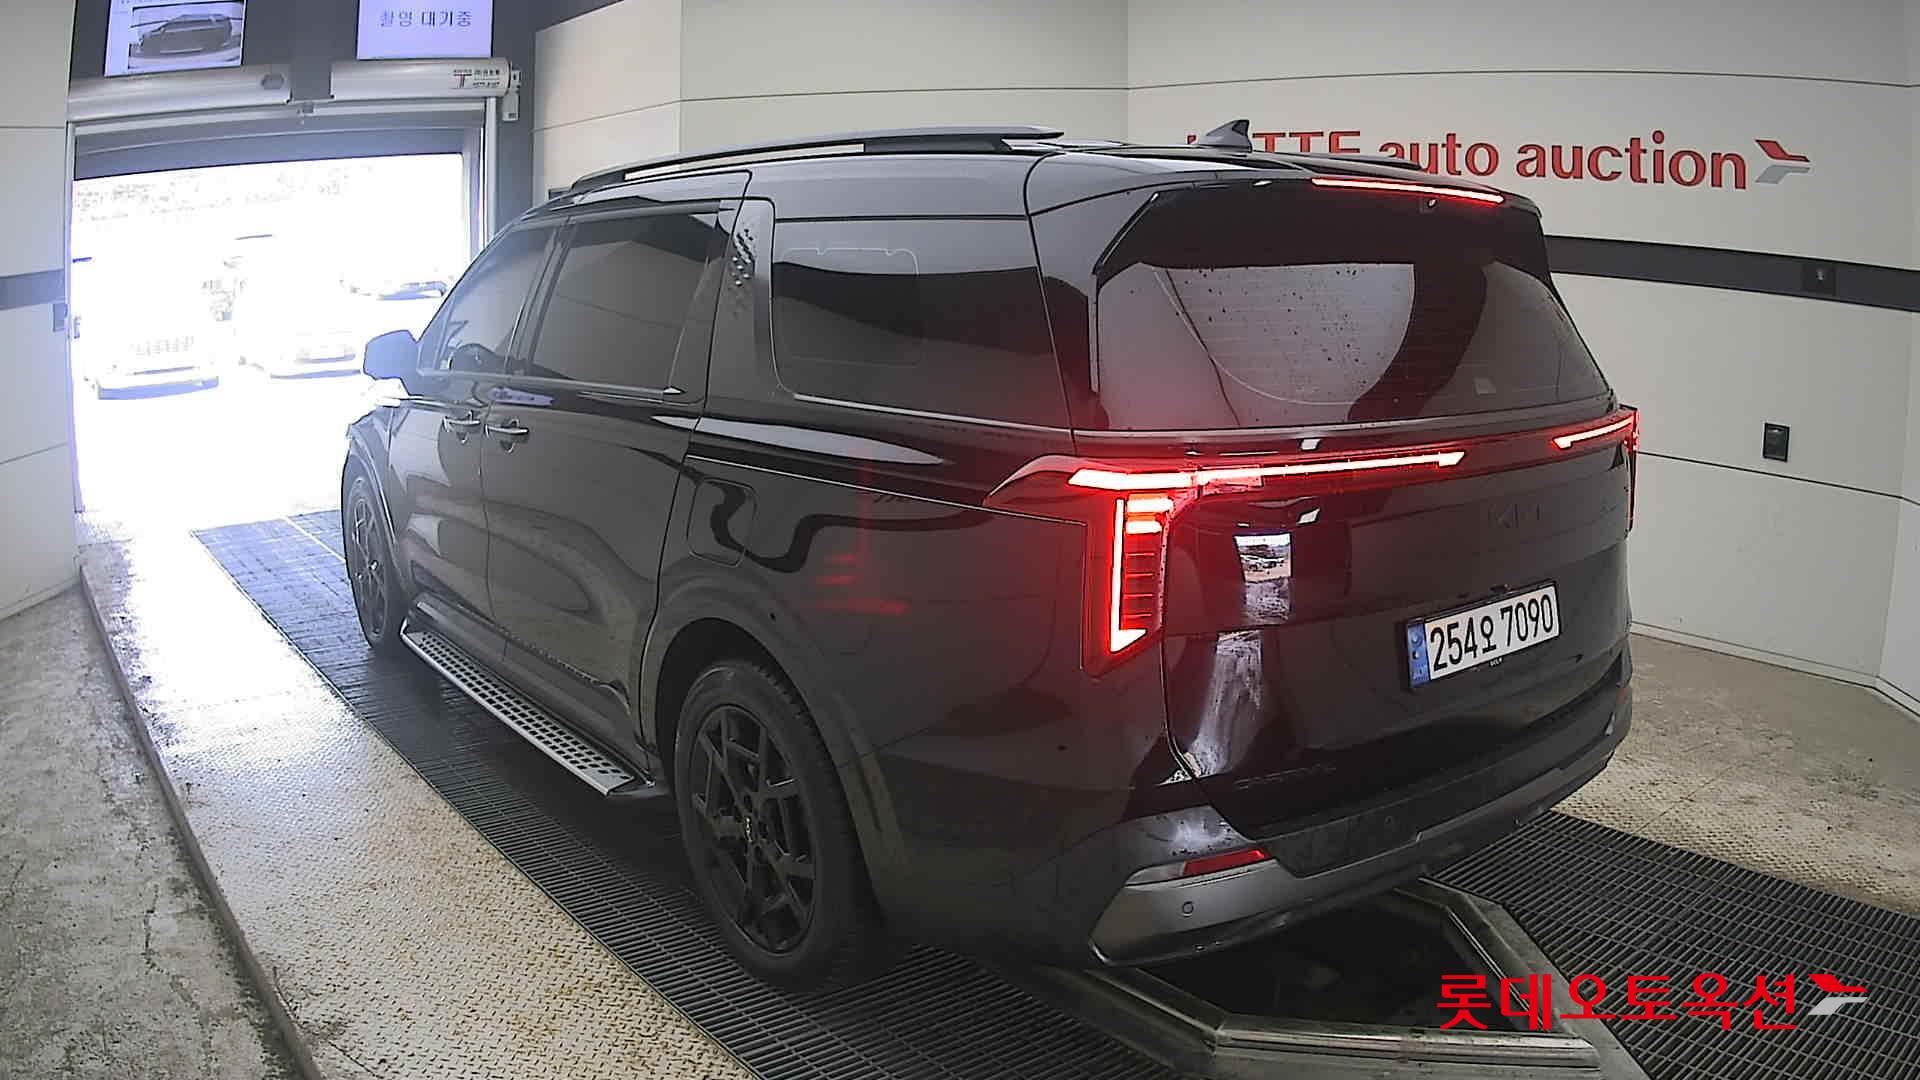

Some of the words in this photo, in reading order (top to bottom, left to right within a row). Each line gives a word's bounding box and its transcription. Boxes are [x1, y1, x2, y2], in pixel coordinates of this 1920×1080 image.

[420, 9, 473, 28] 대기중
[1378, 132, 1499, 176] auto
[1515, 129, 1747, 190] auction
[1430, 615, 1497, 672] 254오
[1500, 594, 1554, 647] 7090
